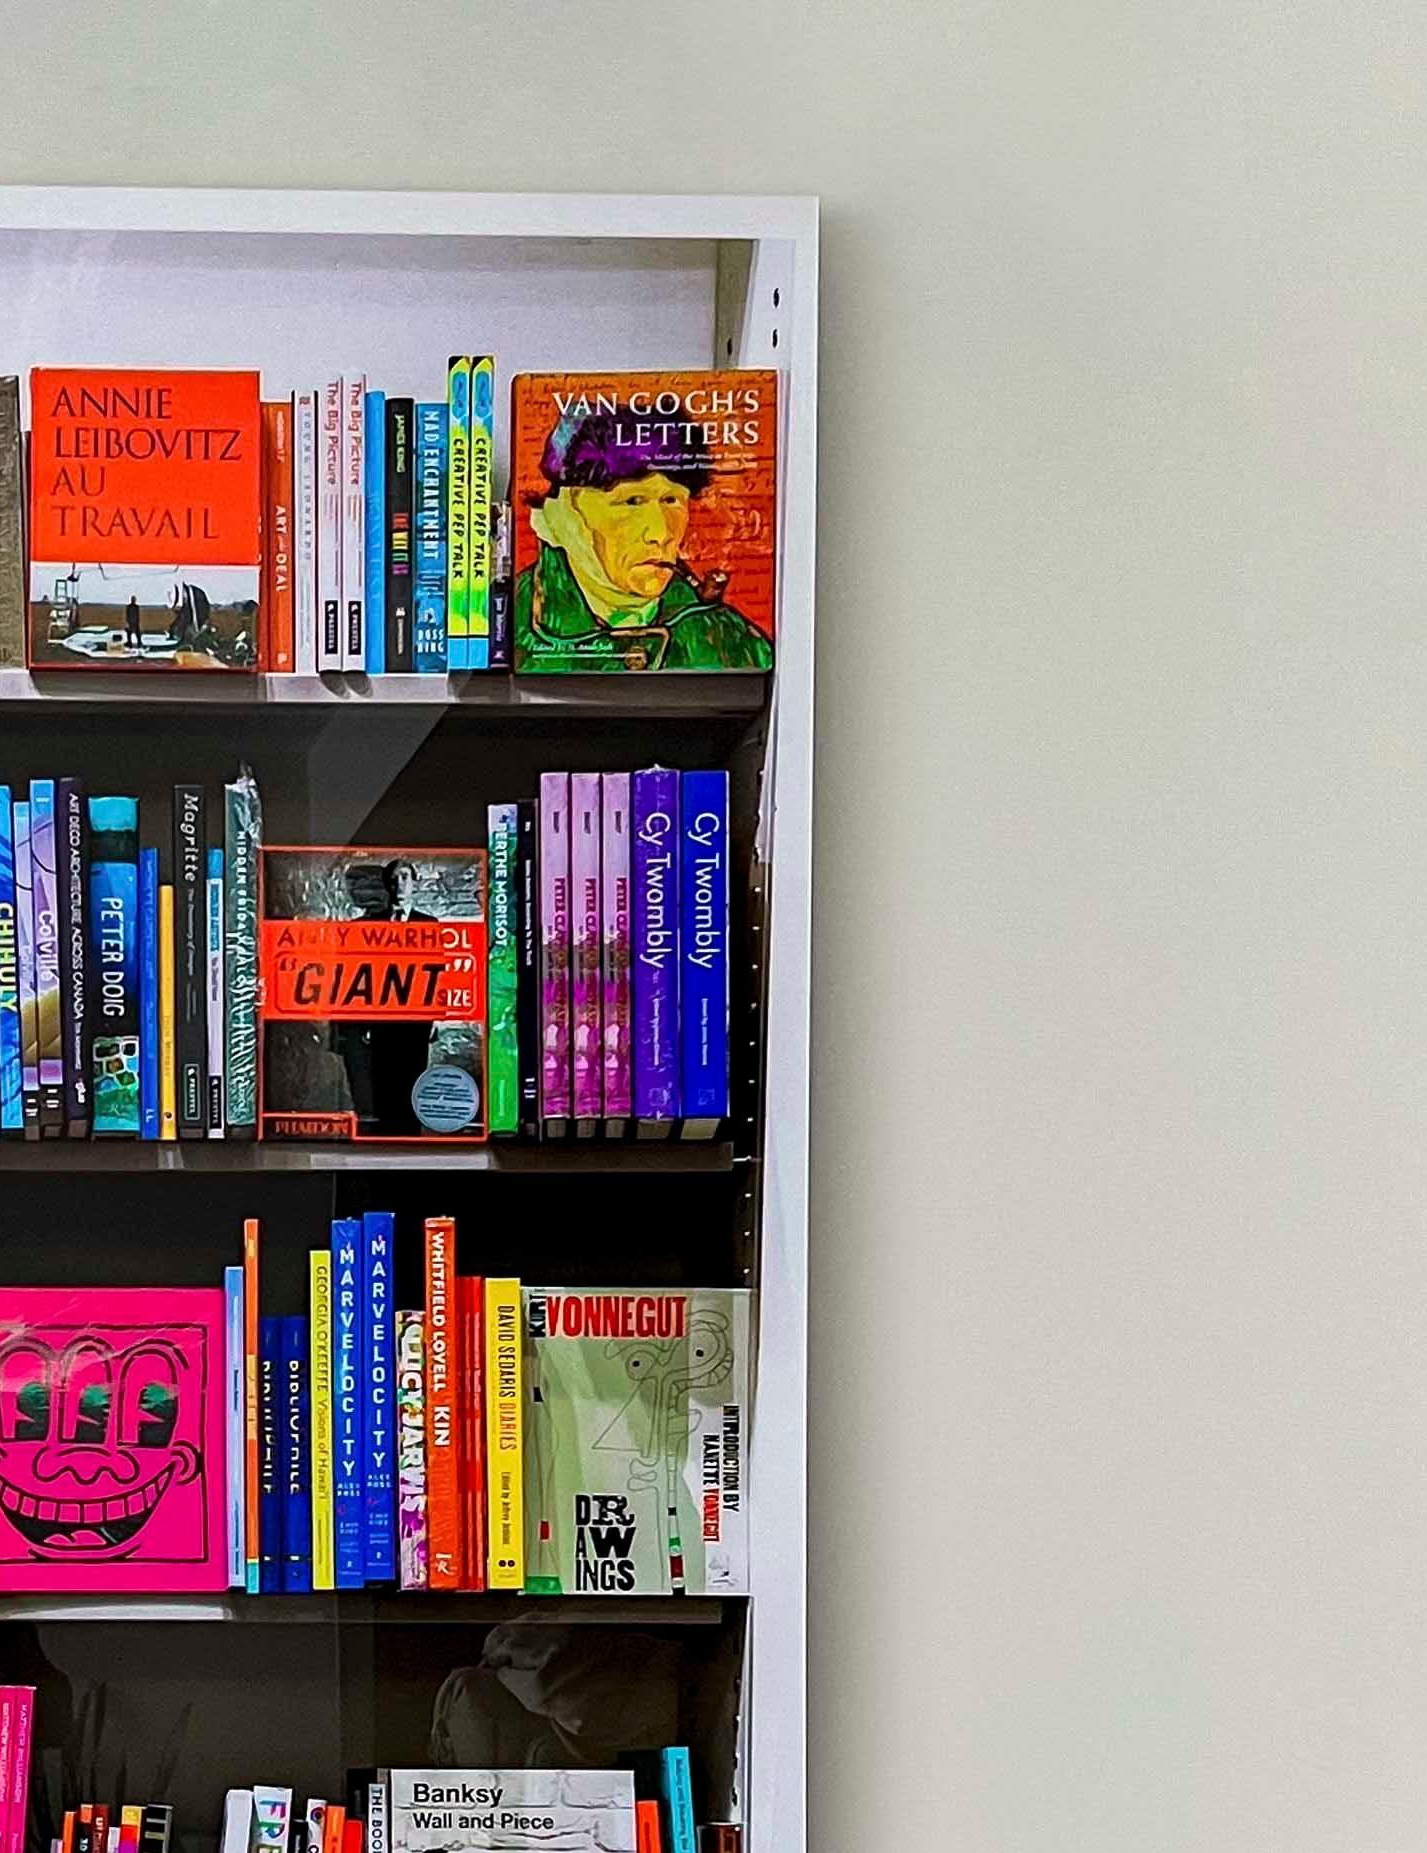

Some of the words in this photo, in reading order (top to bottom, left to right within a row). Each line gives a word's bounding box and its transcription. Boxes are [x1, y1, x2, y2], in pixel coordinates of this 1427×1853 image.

[51, 386, 172, 419] ANNIE
[326, 382, 339, 407] The
[553, 392, 620, 417] VAN
[628, 390, 761, 416] GOGH'S
[325, 410, 338, 431] Big
[615, 421, 760, 448] LETTERS
[53, 428, 244, 462] LEIBOVITZ
[326, 436, 338, 485] Picture
[51, 466, 106, 497] AU
[452, 438, 466, 505] CREATIVE
[474, 438, 488, 505] CREATIVE
[50, 505, 220, 540] TRAVAIL
[275, 505, 287, 533] ART
[452, 513, 465, 537] PEP
[475, 513, 487, 537] PEP
[275, 553, 287, 592] DEAL
[452, 543, 464, 579] TALK
[474, 543, 486, 579] TALK
[69, 793, 80, 814] ART
[69, 816, 81, 846] DECO
[179, 792, 200, 881] Magritte
[639, 812, 671, 845] Cy
[688, 812, 720, 845] Cy
[494, 822, 508, 878] BERTHE
[70, 848, 82, 924] ARCHITECTURE
[494, 880, 508, 947] MORISOT
[639, 852, 672, 969] Twombly
[687, 852, 721, 969] Twombly
[71, 926, 84, 969] ACROSS
[101, 897, 124, 963] PETER
[277, 927, 350, 948] AY
[361, 926, 472, 949] WARHOL
[73, 971, 84, 1019] CANADA
[102, 971, 125, 1016] DOIG
[431, 1231, 446, 1327] WHITFIELD
[497, 1304, 516, 1342] DAVID
[546, 1295, 687, 1338] VONNEGUT
[340, 1248, 355, 1477] MARVELOCITY
[371, 1239, 386, 1469] MARVELOCITY
[433, 1331, 449, 1392] LOVELL
[498, 1346, 516, 1398] SEDARIS
[434, 1405, 451, 1446] KIN
[498, 1402, 517, 1451] DIARIES
[722, 1405, 740, 1491] INTRODUCTION
[575, 1495, 635, 1526] DR
[722, 1493, 740, 1512] BY
[575, 1526, 637, 1559] AW
[575, 1559, 636, 1592] INGS
[371, 1788, 383, 1814] THE
[413, 1783, 504, 1808] Banksy
[413, 1813, 456, 1830] Wall
[458, 1813, 497, 1830] and
[499, 1813, 555, 1830] Piece
